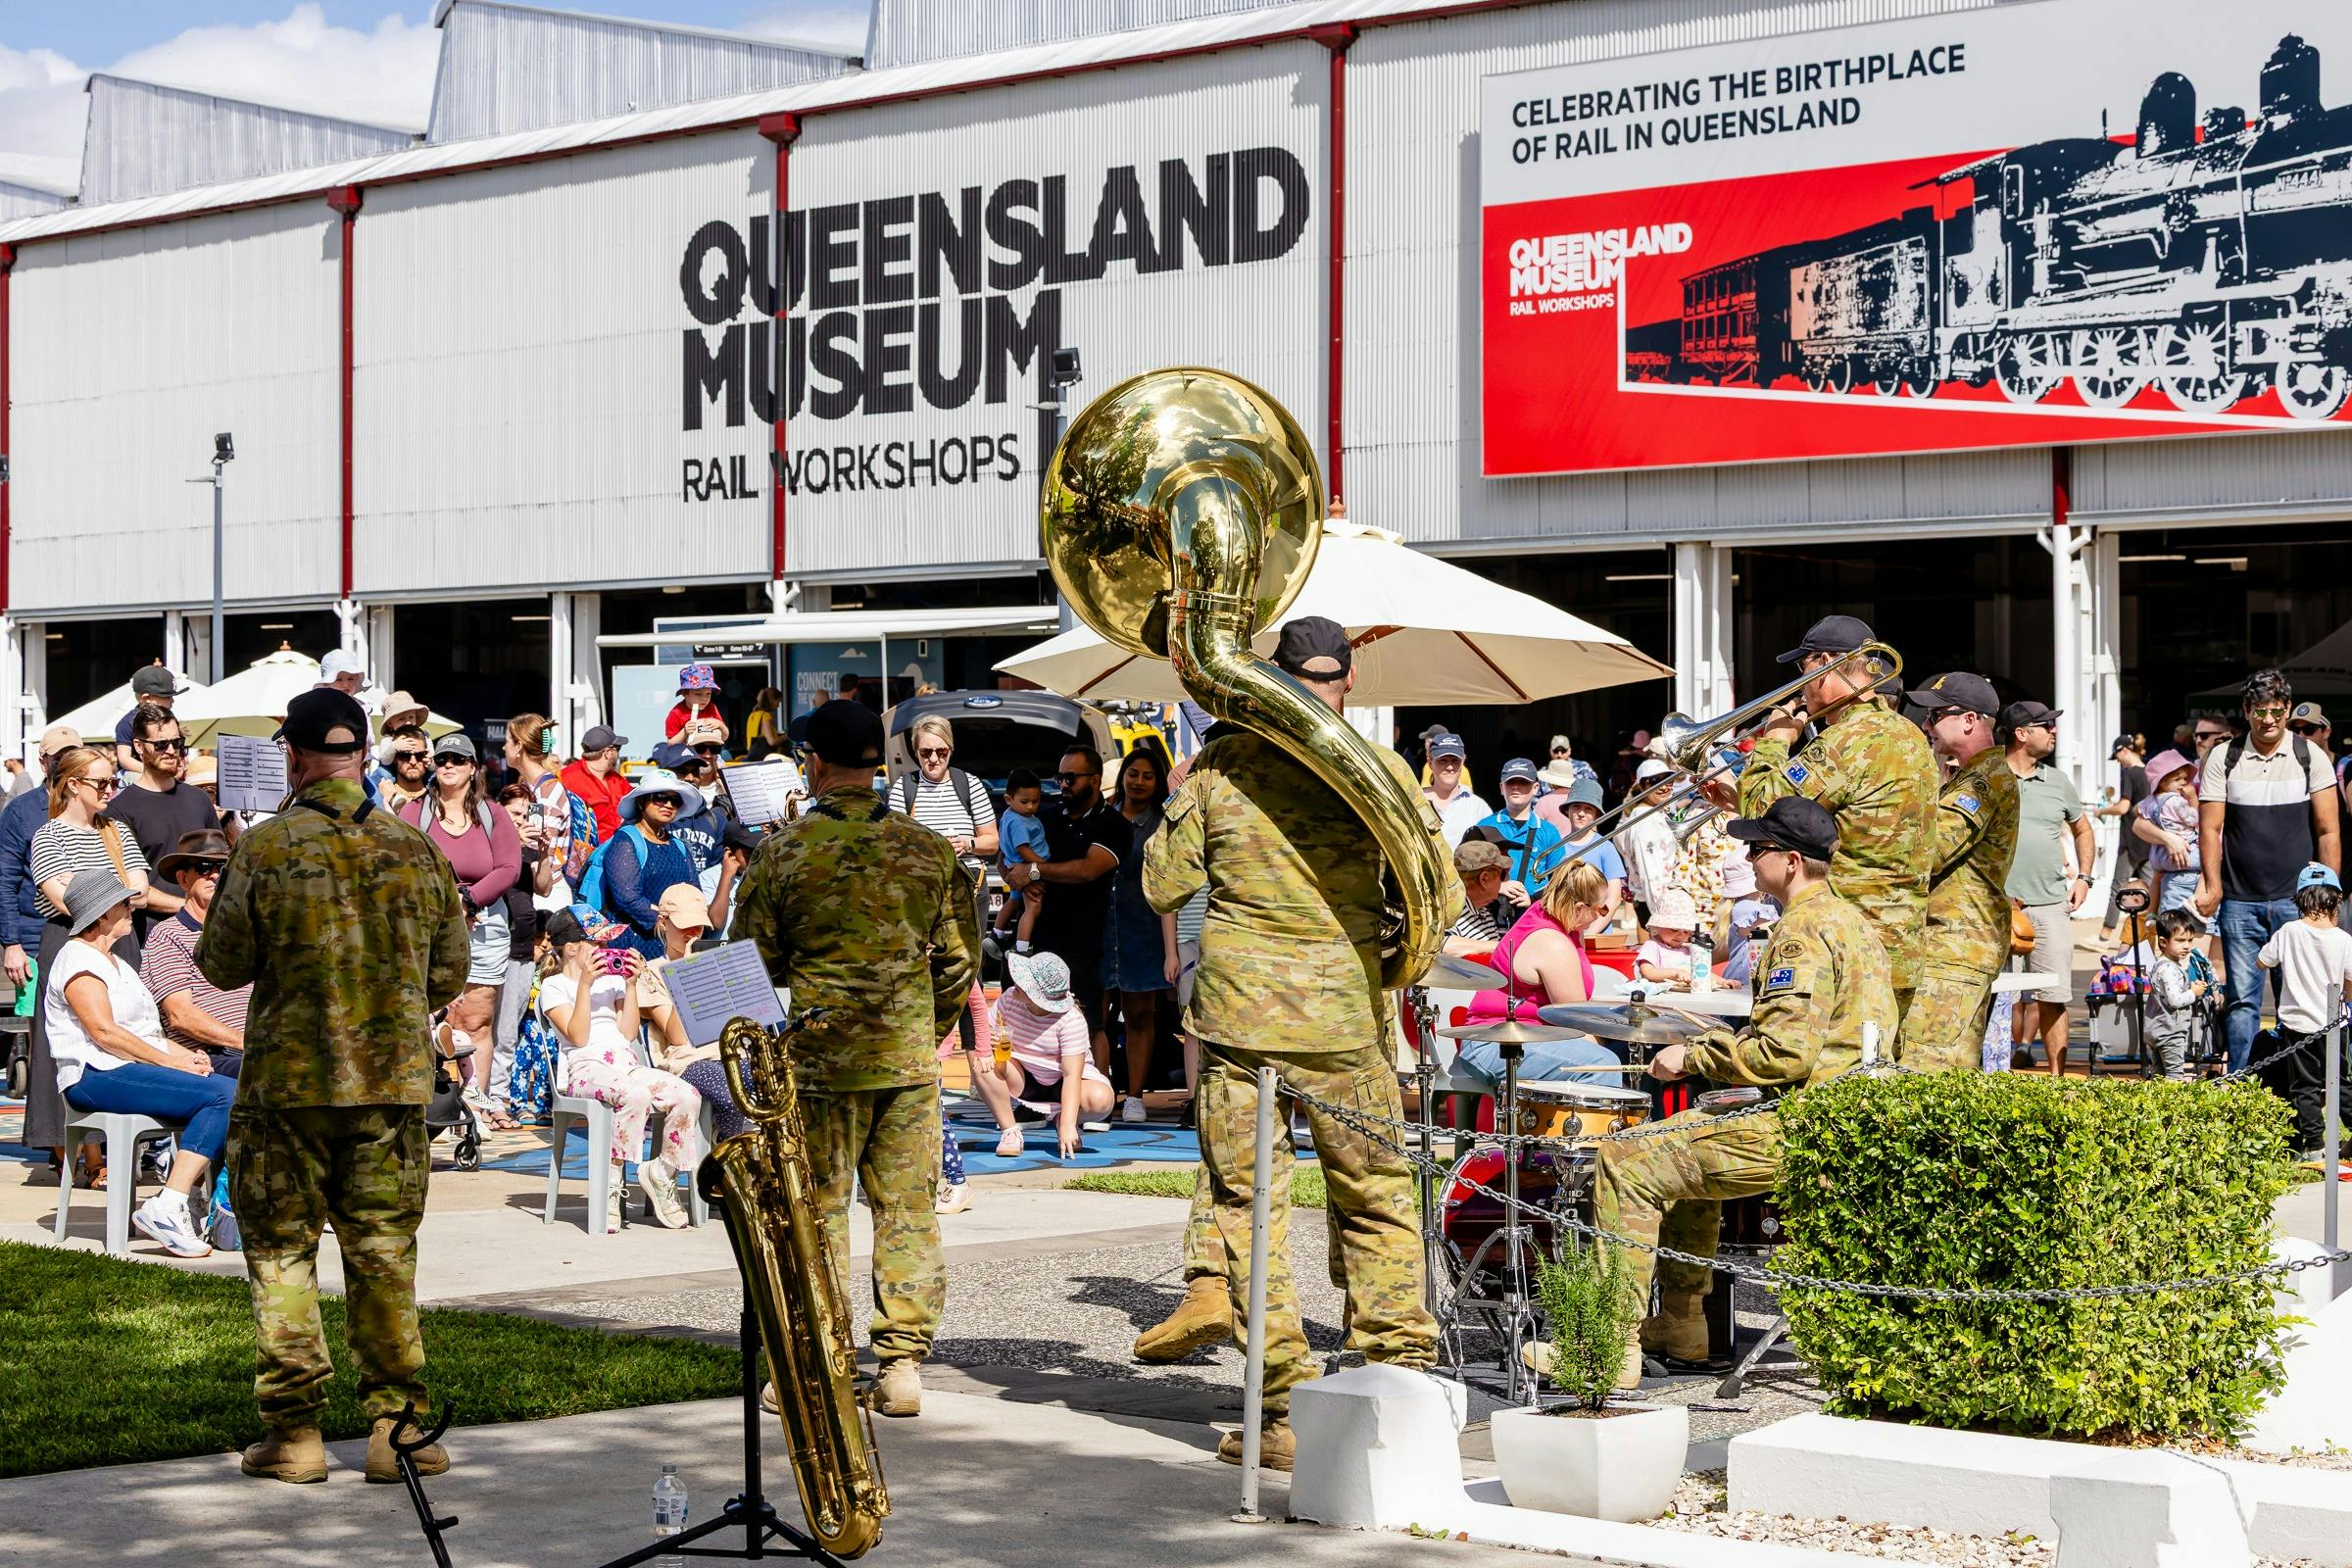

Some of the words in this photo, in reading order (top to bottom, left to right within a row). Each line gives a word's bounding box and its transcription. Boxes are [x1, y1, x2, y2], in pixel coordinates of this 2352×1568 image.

[1512, 78, 1700, 127] CELEBRATING
[1709, 69, 1767, 103] THE
[1776, 43, 1965, 95] BIRTHPLACE
[1512, 135, 1547, 165] OF
[1555, 126, 1617, 160] RAIL
[1626, 122, 1652, 151] IN
[1661, 96, 1861, 146] QUEENSLAND
[680, 147, 1310, 324] QUEENSLAND
[1509, 222, 1692, 269] QUEENSLAND
[1510, 257, 1626, 297] MUSEUM
[1510, 301, 1536, 317] RAIL
[1538, 293, 1615, 315] WORKSHOPS
[683, 288, 1062, 431] MUSEUM
[683, 455, 759, 503] RAIL
[769, 433, 1020, 496] WORKSHOPS
[797, 671, 838, 691] CONNECT
